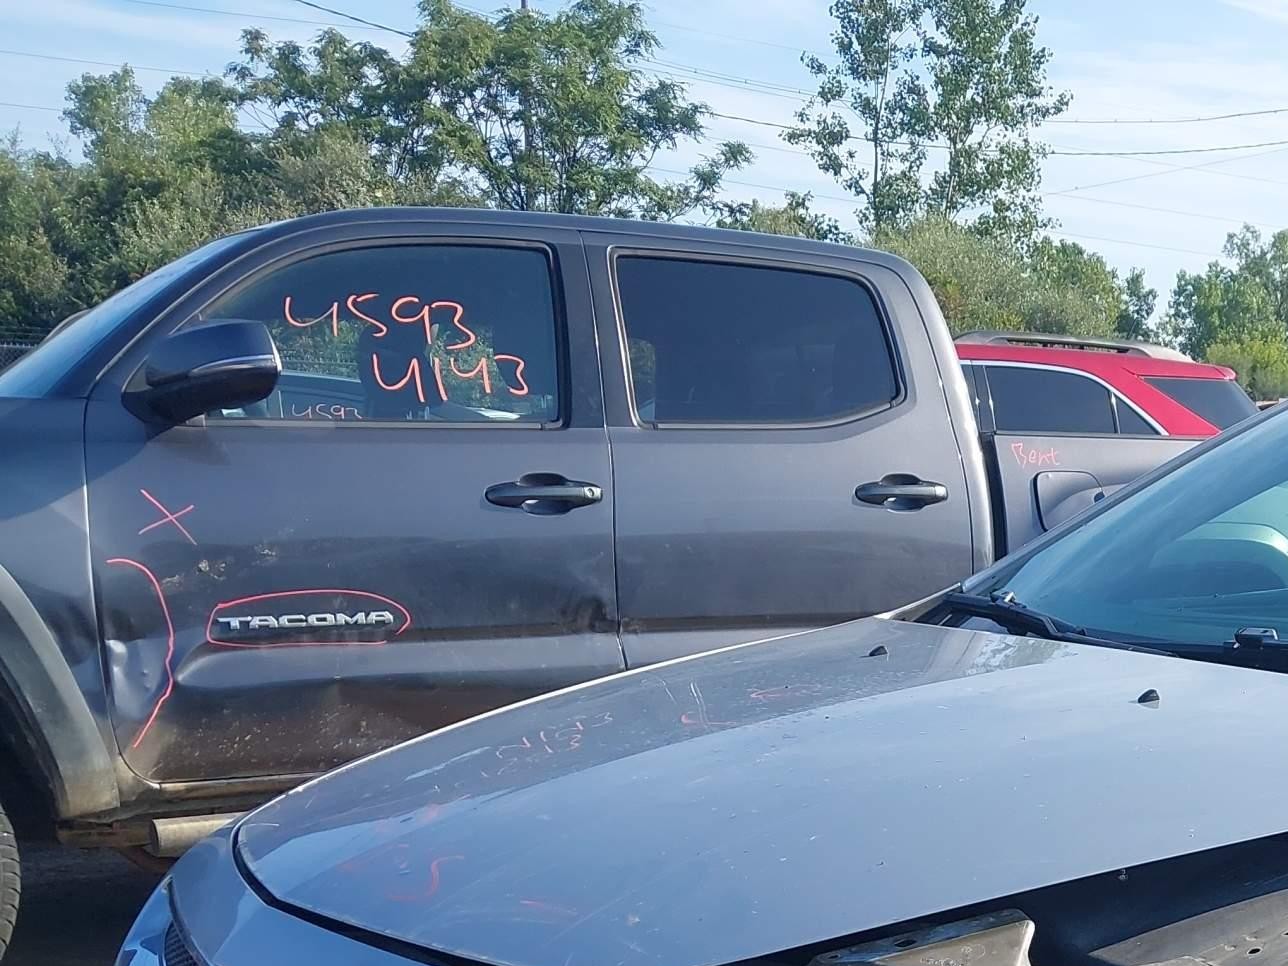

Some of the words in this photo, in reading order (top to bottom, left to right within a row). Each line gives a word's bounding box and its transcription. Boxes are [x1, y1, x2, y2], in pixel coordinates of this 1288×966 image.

[284, 293, 476, 350] 4593
[372, 353, 529, 403] 4143
[1011, 442, 1061, 469] Bent
[216, 610, 395, 631] TACOMA
